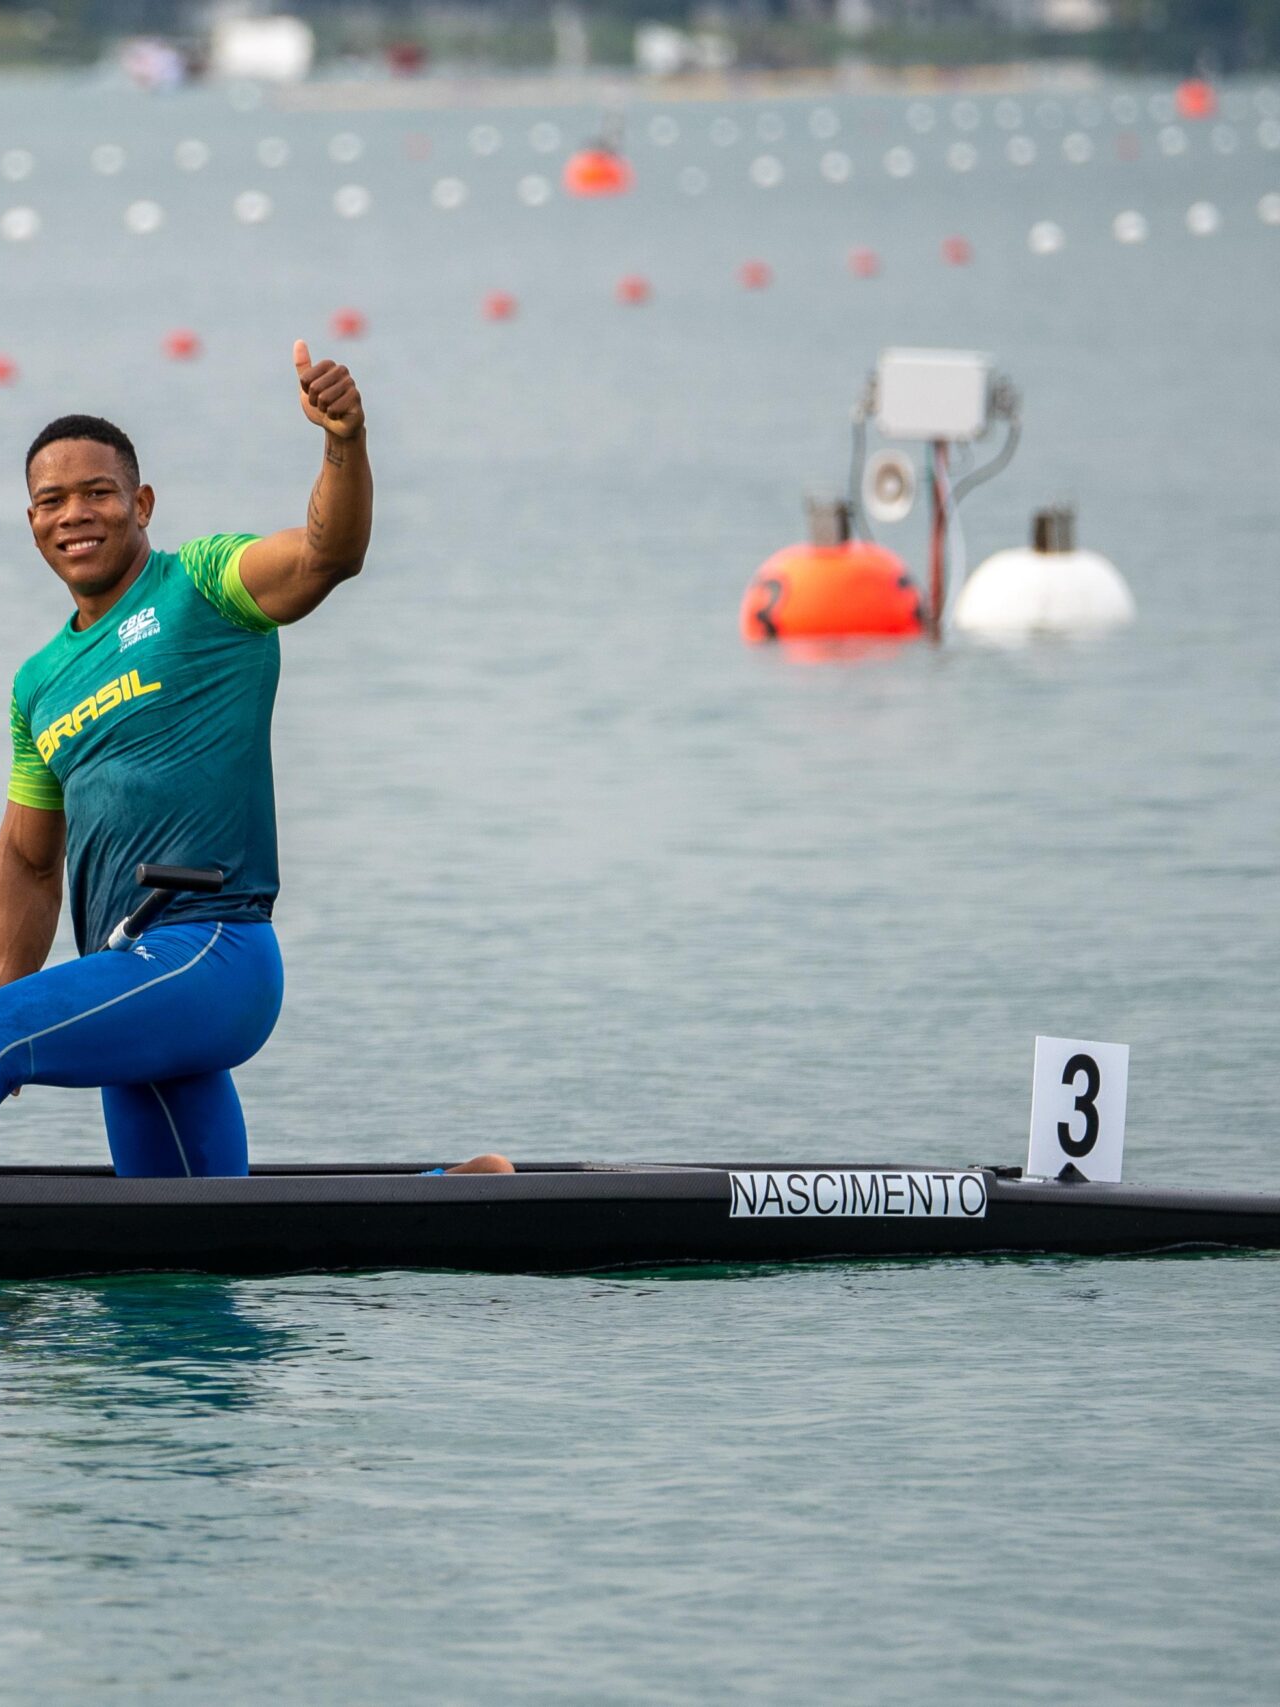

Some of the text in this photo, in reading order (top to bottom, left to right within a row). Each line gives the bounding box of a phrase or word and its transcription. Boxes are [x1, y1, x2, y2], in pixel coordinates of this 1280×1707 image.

[36, 669, 161, 764] BRASIL
[1057, 1053, 1100, 1158] 3
[731, 1173, 987, 1217] NASCIMENTO
